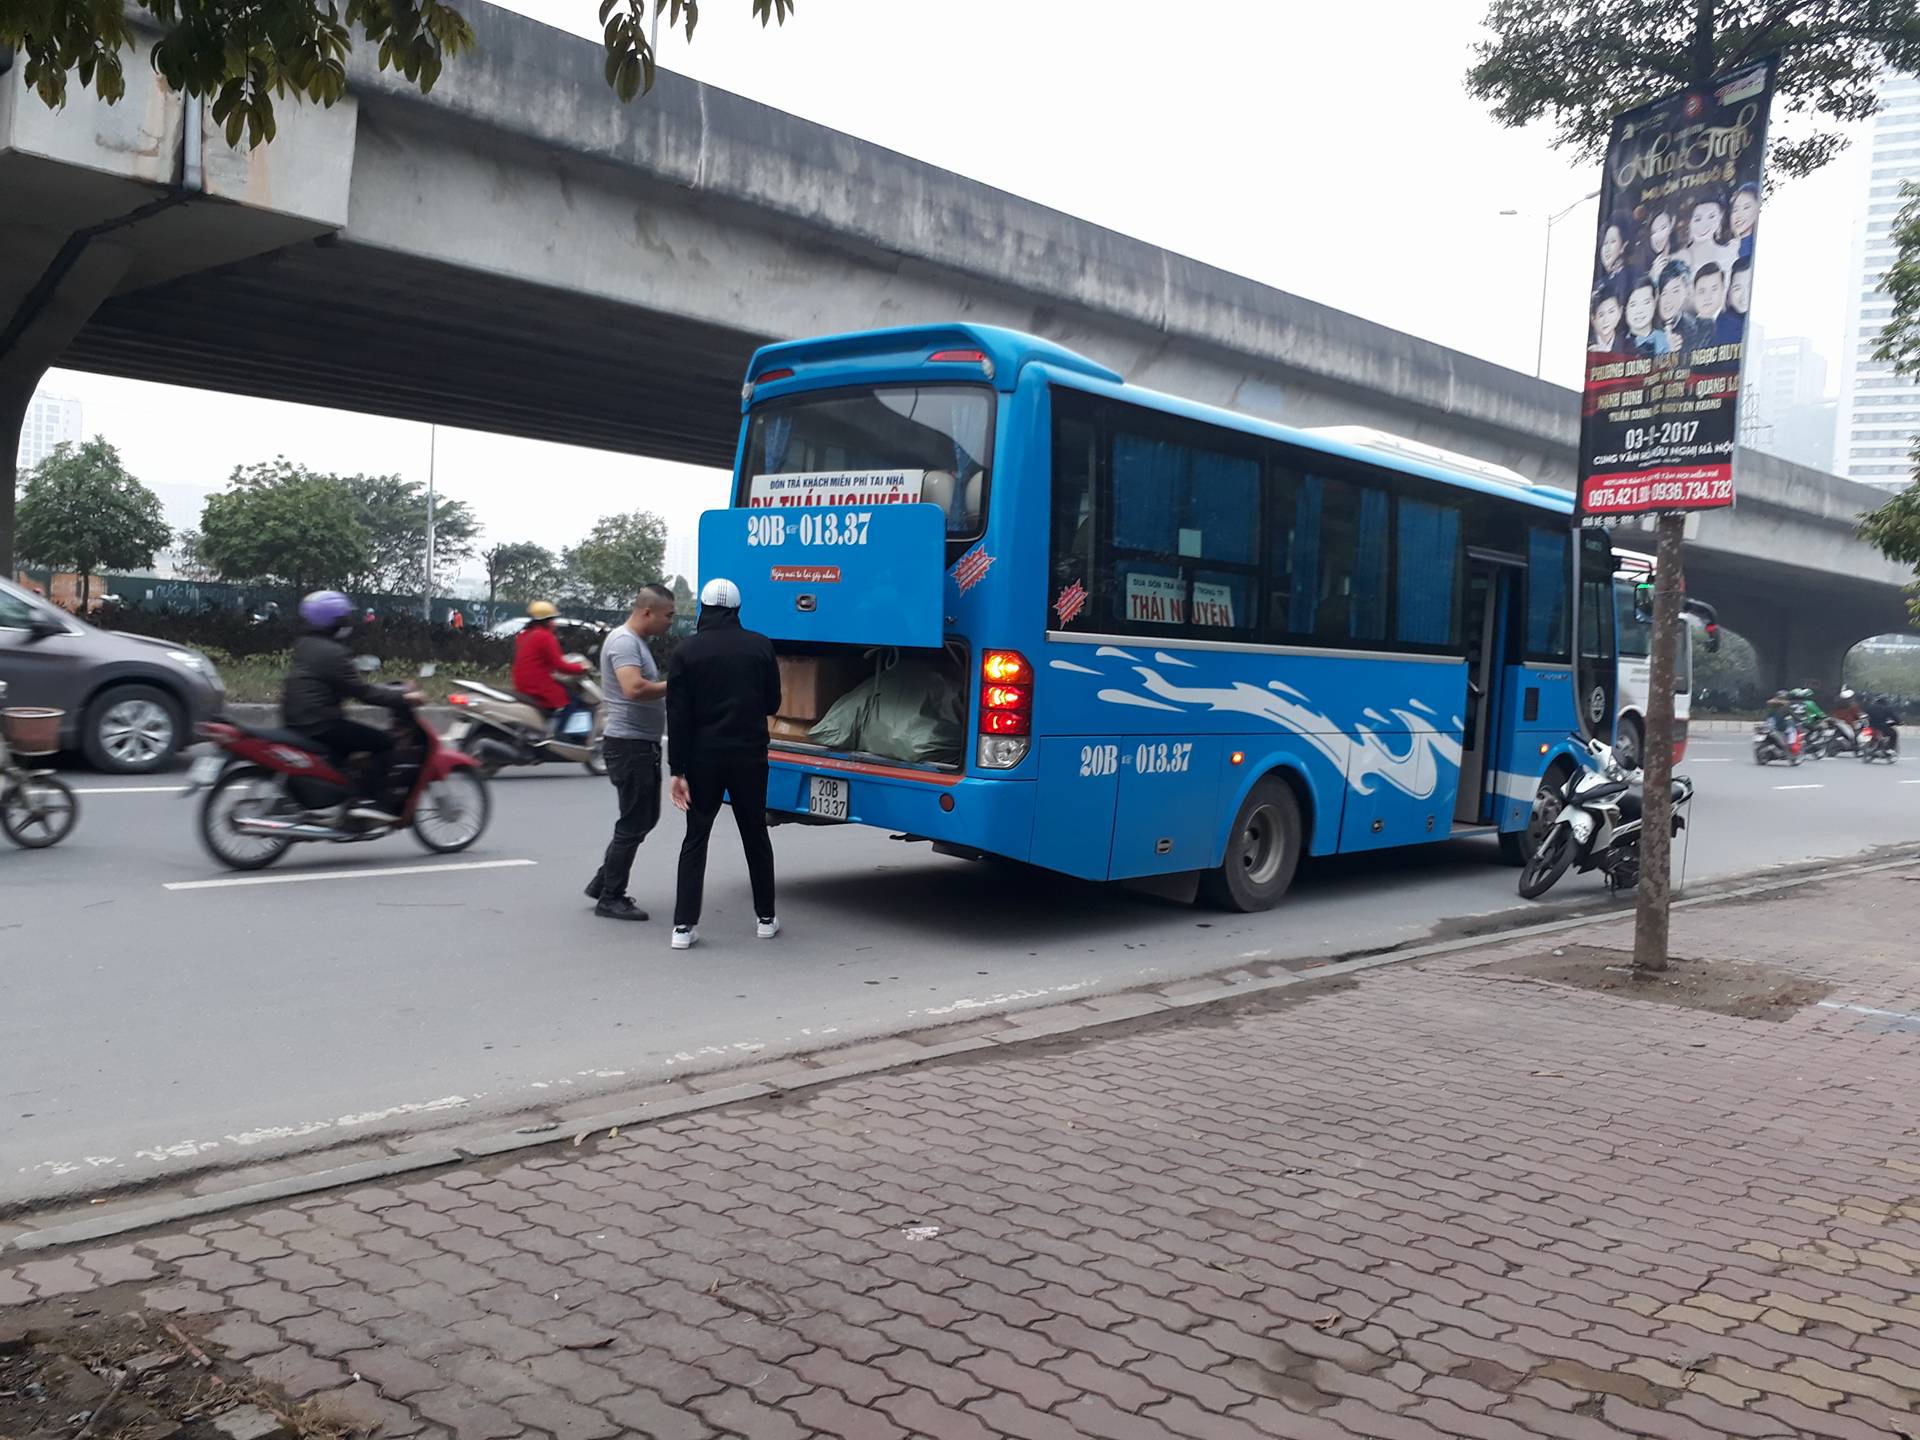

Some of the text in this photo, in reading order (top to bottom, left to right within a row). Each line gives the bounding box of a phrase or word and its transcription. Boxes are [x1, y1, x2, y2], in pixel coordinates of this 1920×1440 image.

[803, 477, 829, 488] KHÁCH
[748, 512, 872, 547] 20B 013.37
[1131, 591, 1231, 627] THÁI NUYÊN
[1080, 743, 1192, 777] 20B 013.37
[819, 780, 839, 798] 20B
